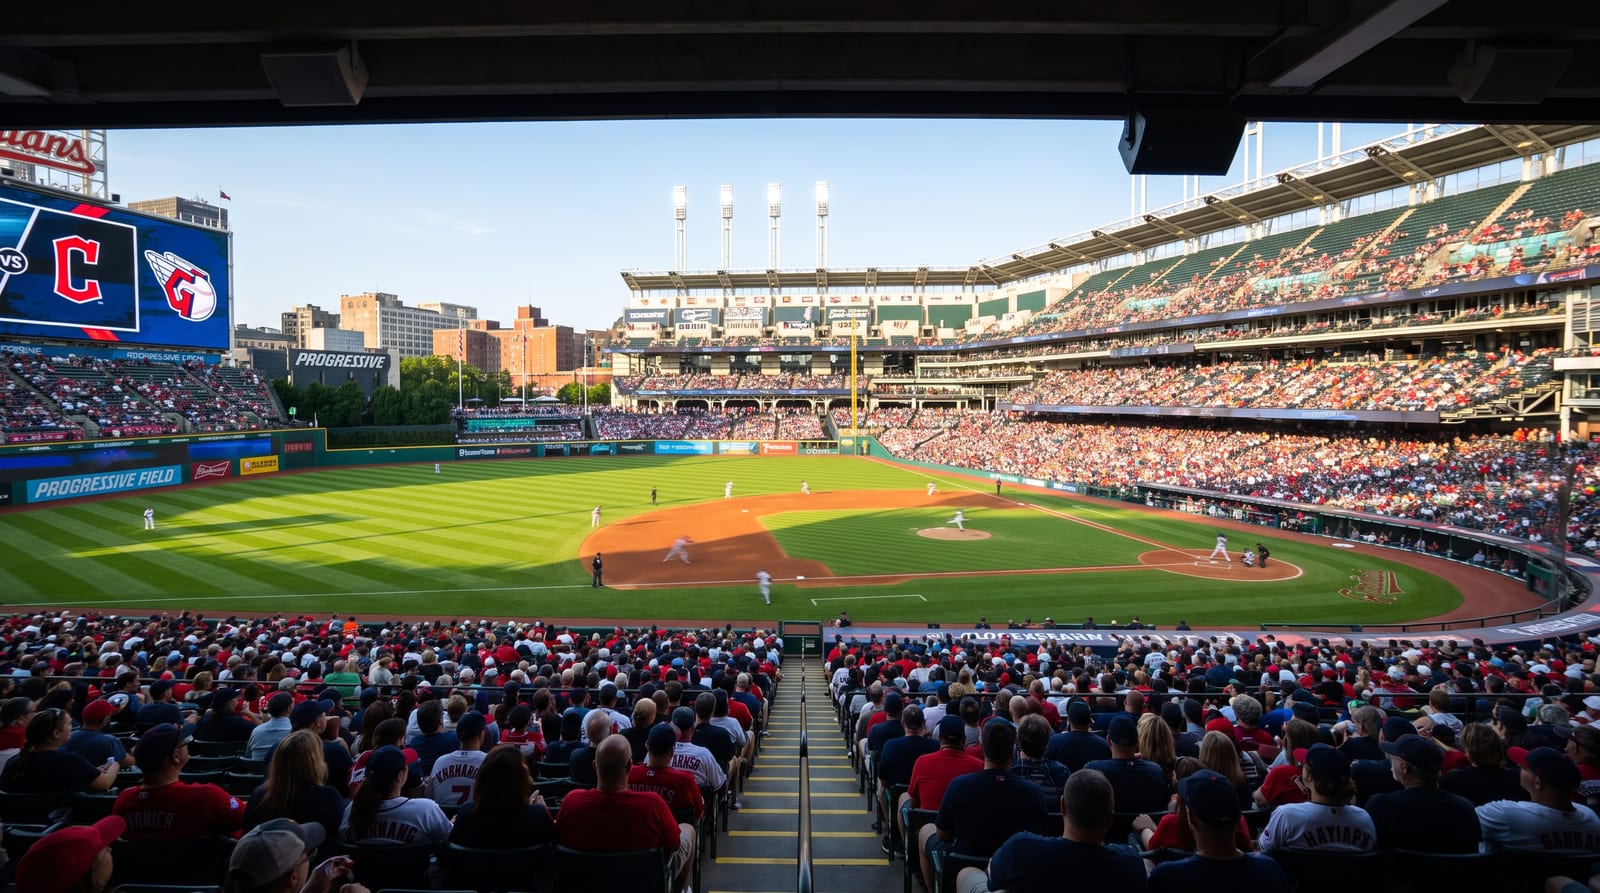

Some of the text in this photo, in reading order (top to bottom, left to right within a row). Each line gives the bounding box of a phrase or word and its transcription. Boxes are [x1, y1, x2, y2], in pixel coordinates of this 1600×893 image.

[0, 255, 22, 268] VS
[53, 236, 102, 304] C
[295, 353, 386, 369] PROGRESSIVE
[34, 468, 175, 499] PROGRESSIVE FIELD
[452, 785, 471, 805] 7
